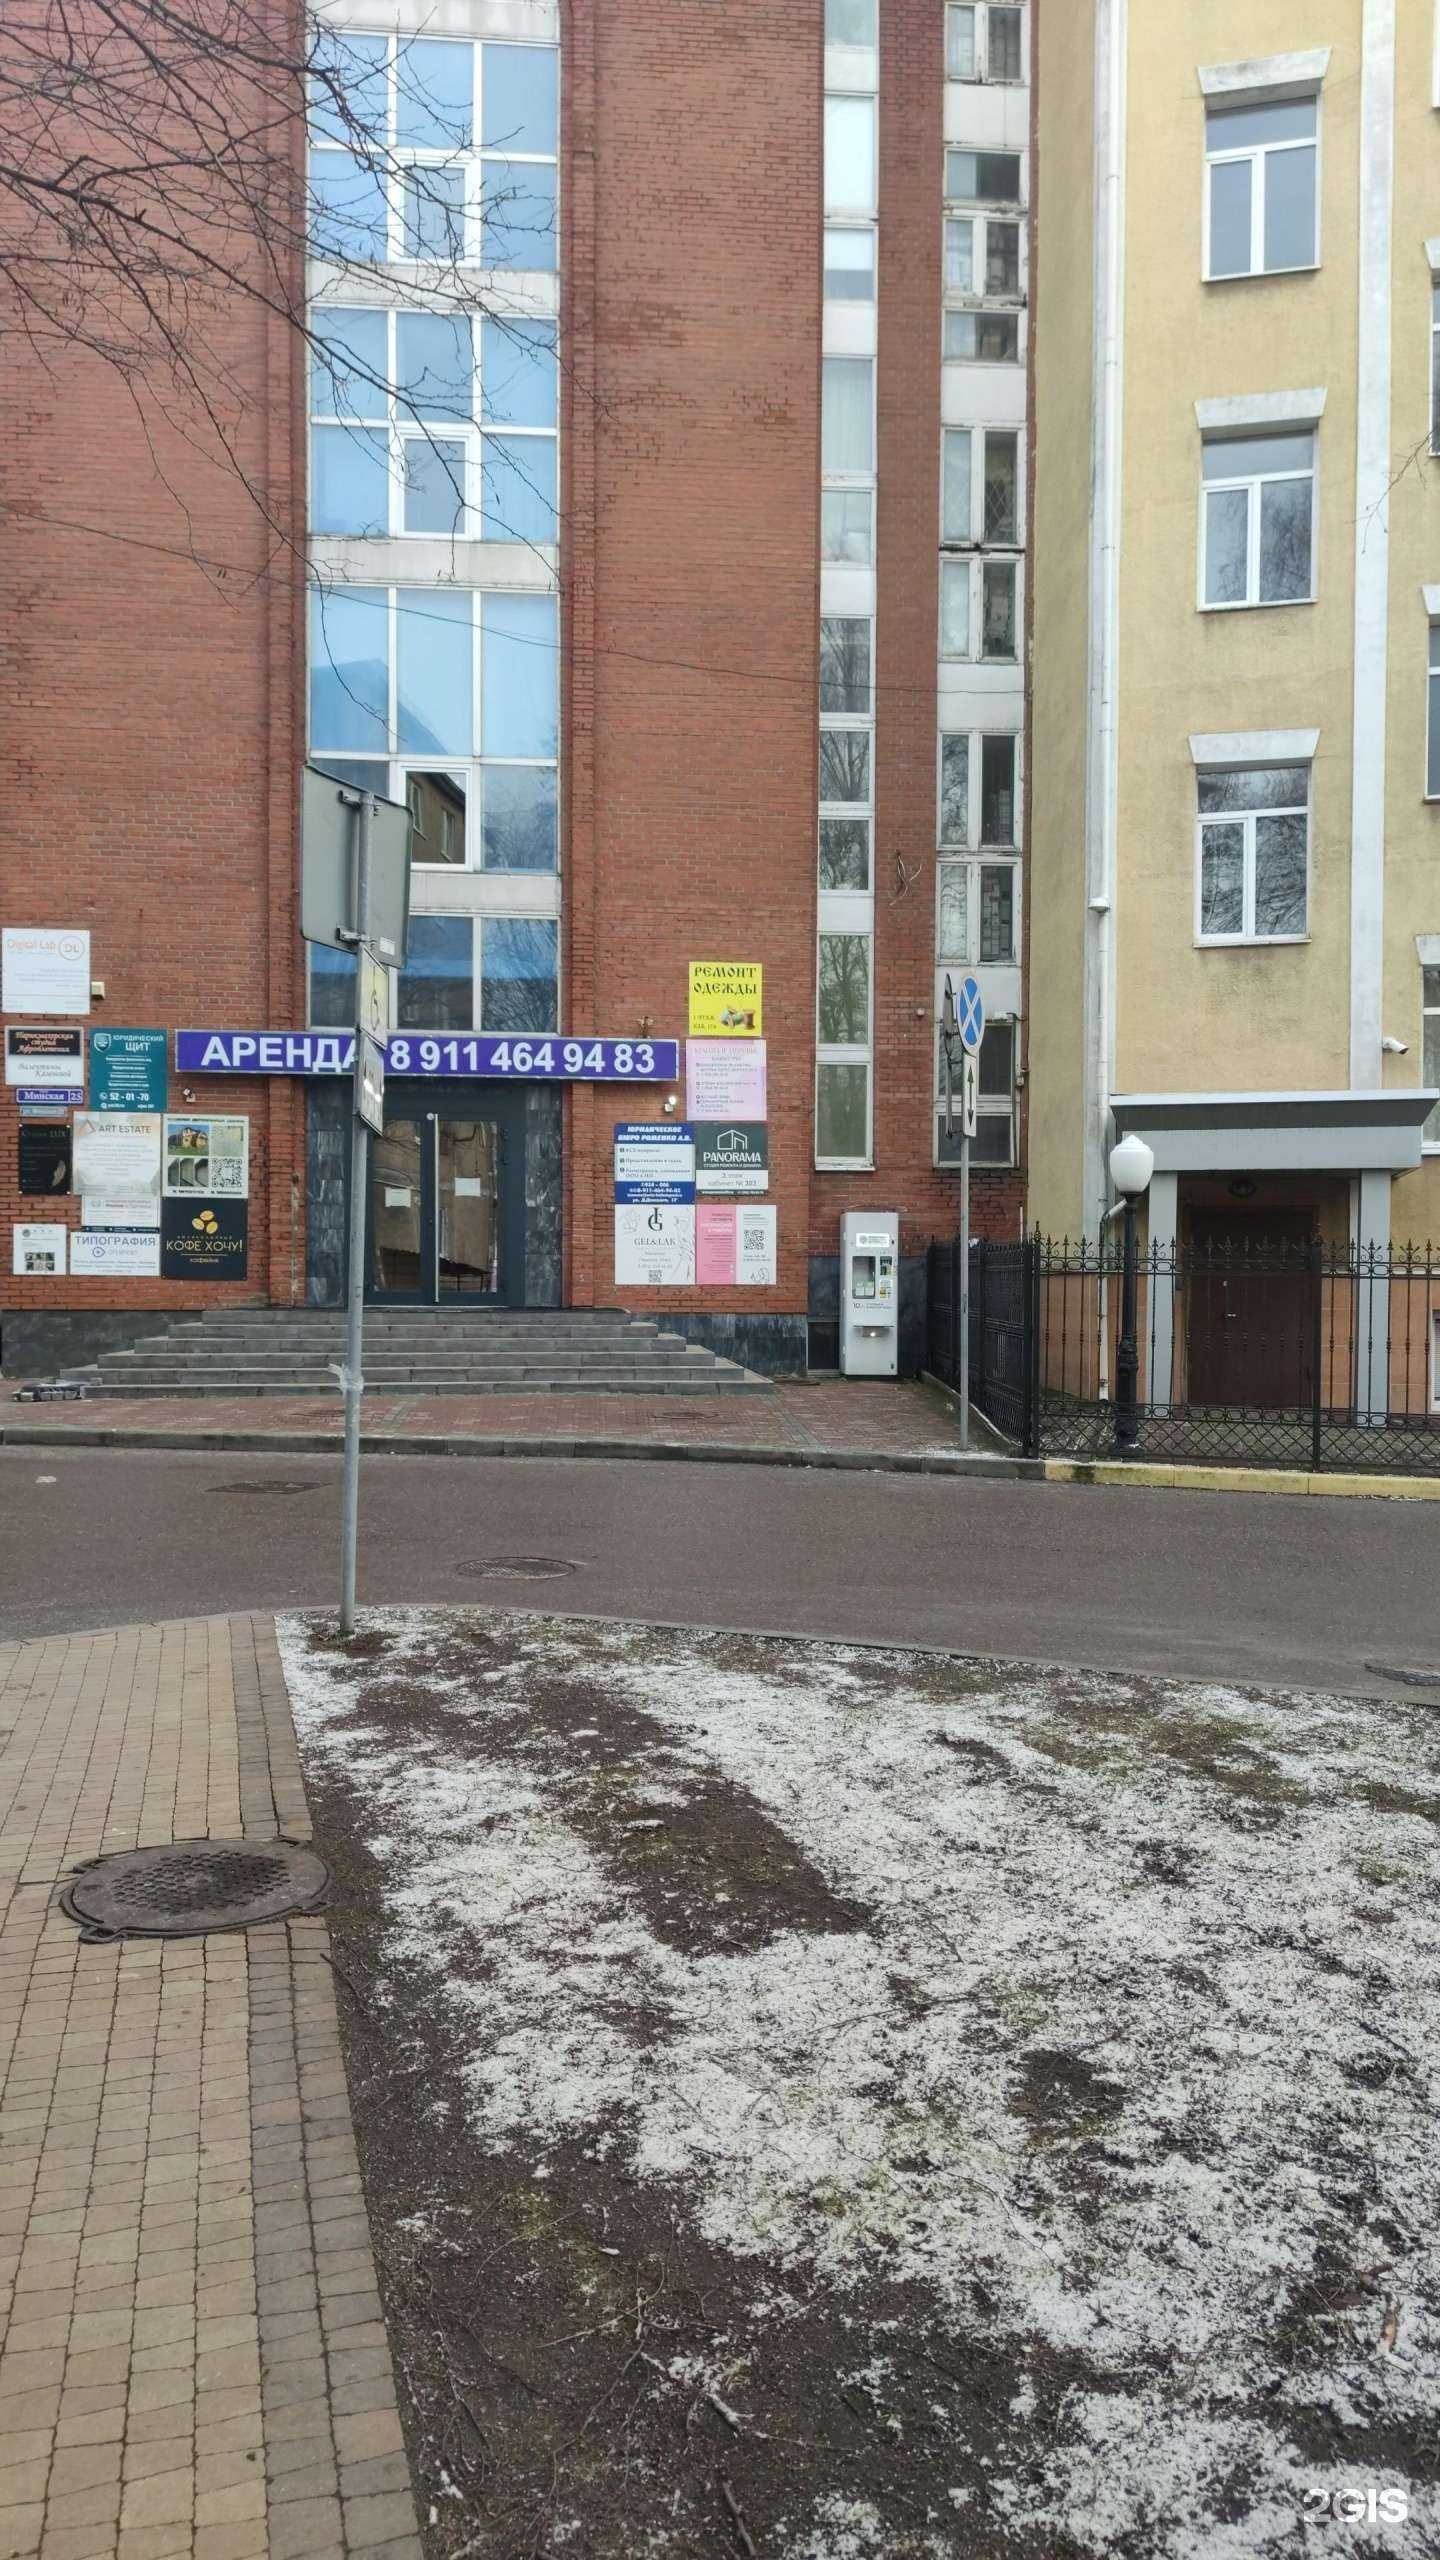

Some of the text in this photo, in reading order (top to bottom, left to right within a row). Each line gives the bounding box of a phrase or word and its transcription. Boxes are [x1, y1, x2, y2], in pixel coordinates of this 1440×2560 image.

[694, 966, 757, 978] РЕМОНТ
[693, 982, 757, 996] ОДЕЖДЫ
[113, 1034, 164, 1042] ЮРИДИЧЕСКИЙ
[125, 1042, 150, 1052] ЩИТ
[390, 1040, 411, 1070] 8
[419, 1040, 478, 1071] 911
[490, 1042, 555, 1072] 464
[563, 1043, 606, 1073] 94
[614, 1043, 655, 1074] 83
[24, 1091, 81, 1101] Минская 25
[98, 1124, 152, 1134] ART ESTATE
[703, 1151, 762, 1162] PANORAMA
[75, 1235, 156, 1247] ТИПОГРАФИЯ
[166, 1239, 243, 1253] КОФЕ ХОЧУ!
